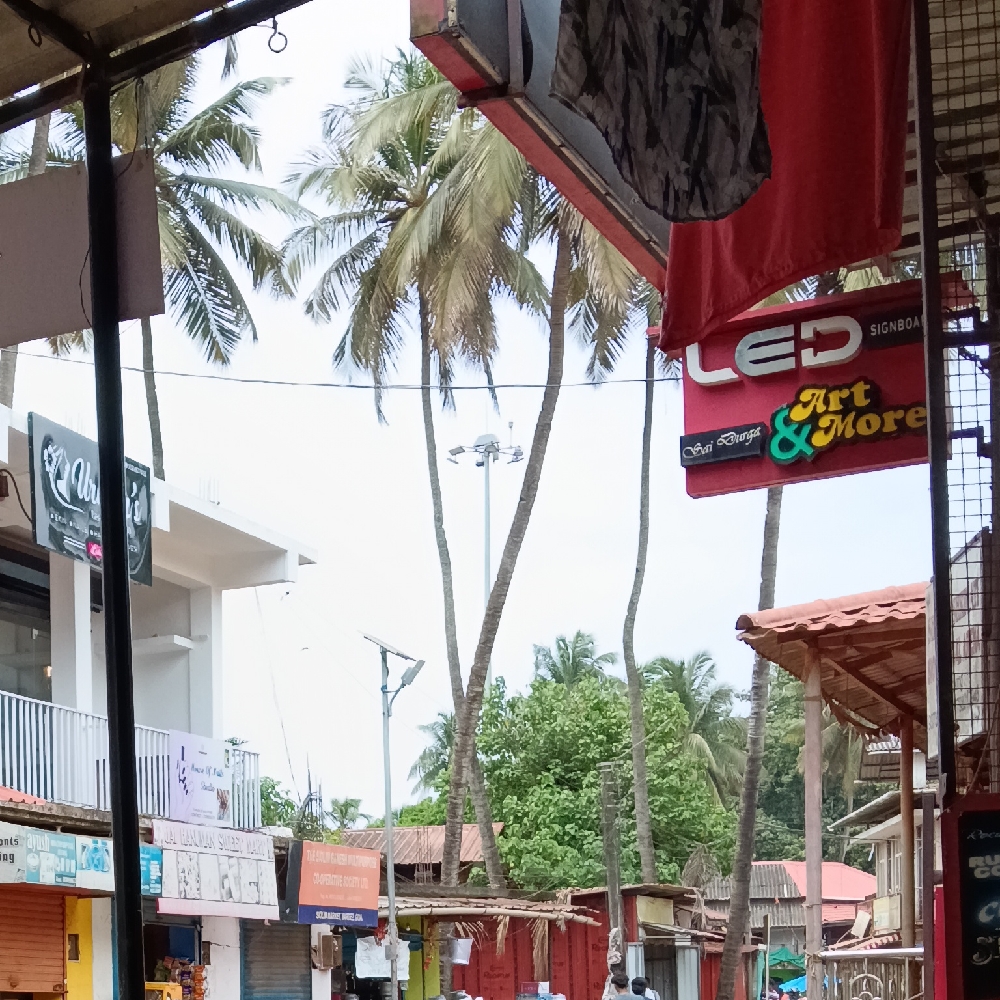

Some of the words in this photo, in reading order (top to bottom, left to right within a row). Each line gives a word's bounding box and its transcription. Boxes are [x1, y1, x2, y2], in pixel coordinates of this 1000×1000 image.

[686, 315, 863, 387] LED
[870, 314, 928, 337] SIGNBOA
[789, 379, 871, 422] Art
[769, 406, 815, 462] &
[811, 404, 927, 448] More
